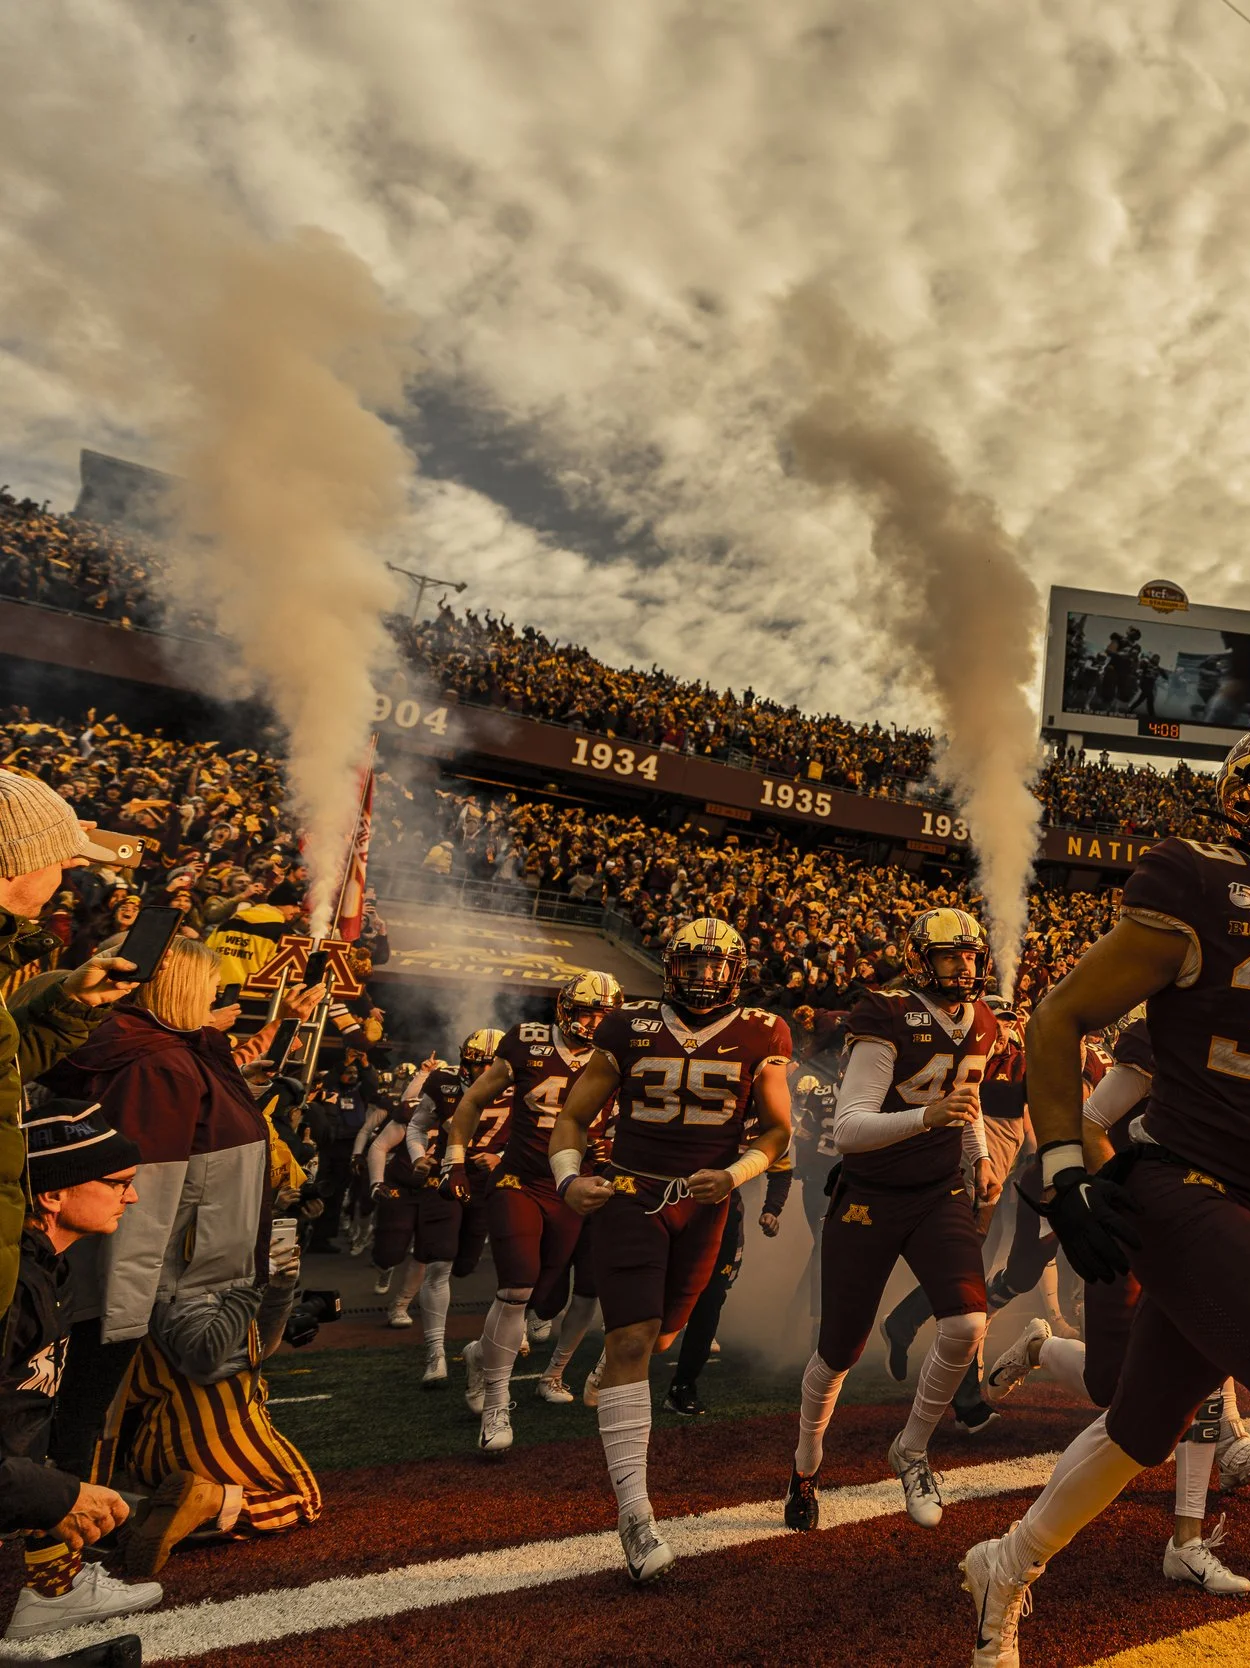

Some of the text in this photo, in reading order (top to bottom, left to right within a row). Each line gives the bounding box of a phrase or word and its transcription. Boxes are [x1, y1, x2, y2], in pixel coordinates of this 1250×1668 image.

[371, 692, 449, 736] 904
[1148, 722, 1179, 737] 4:08
[571, 737, 659, 781] 1934
[760, 780, 832, 817] 1935
[630, 1057, 742, 1126] 35
